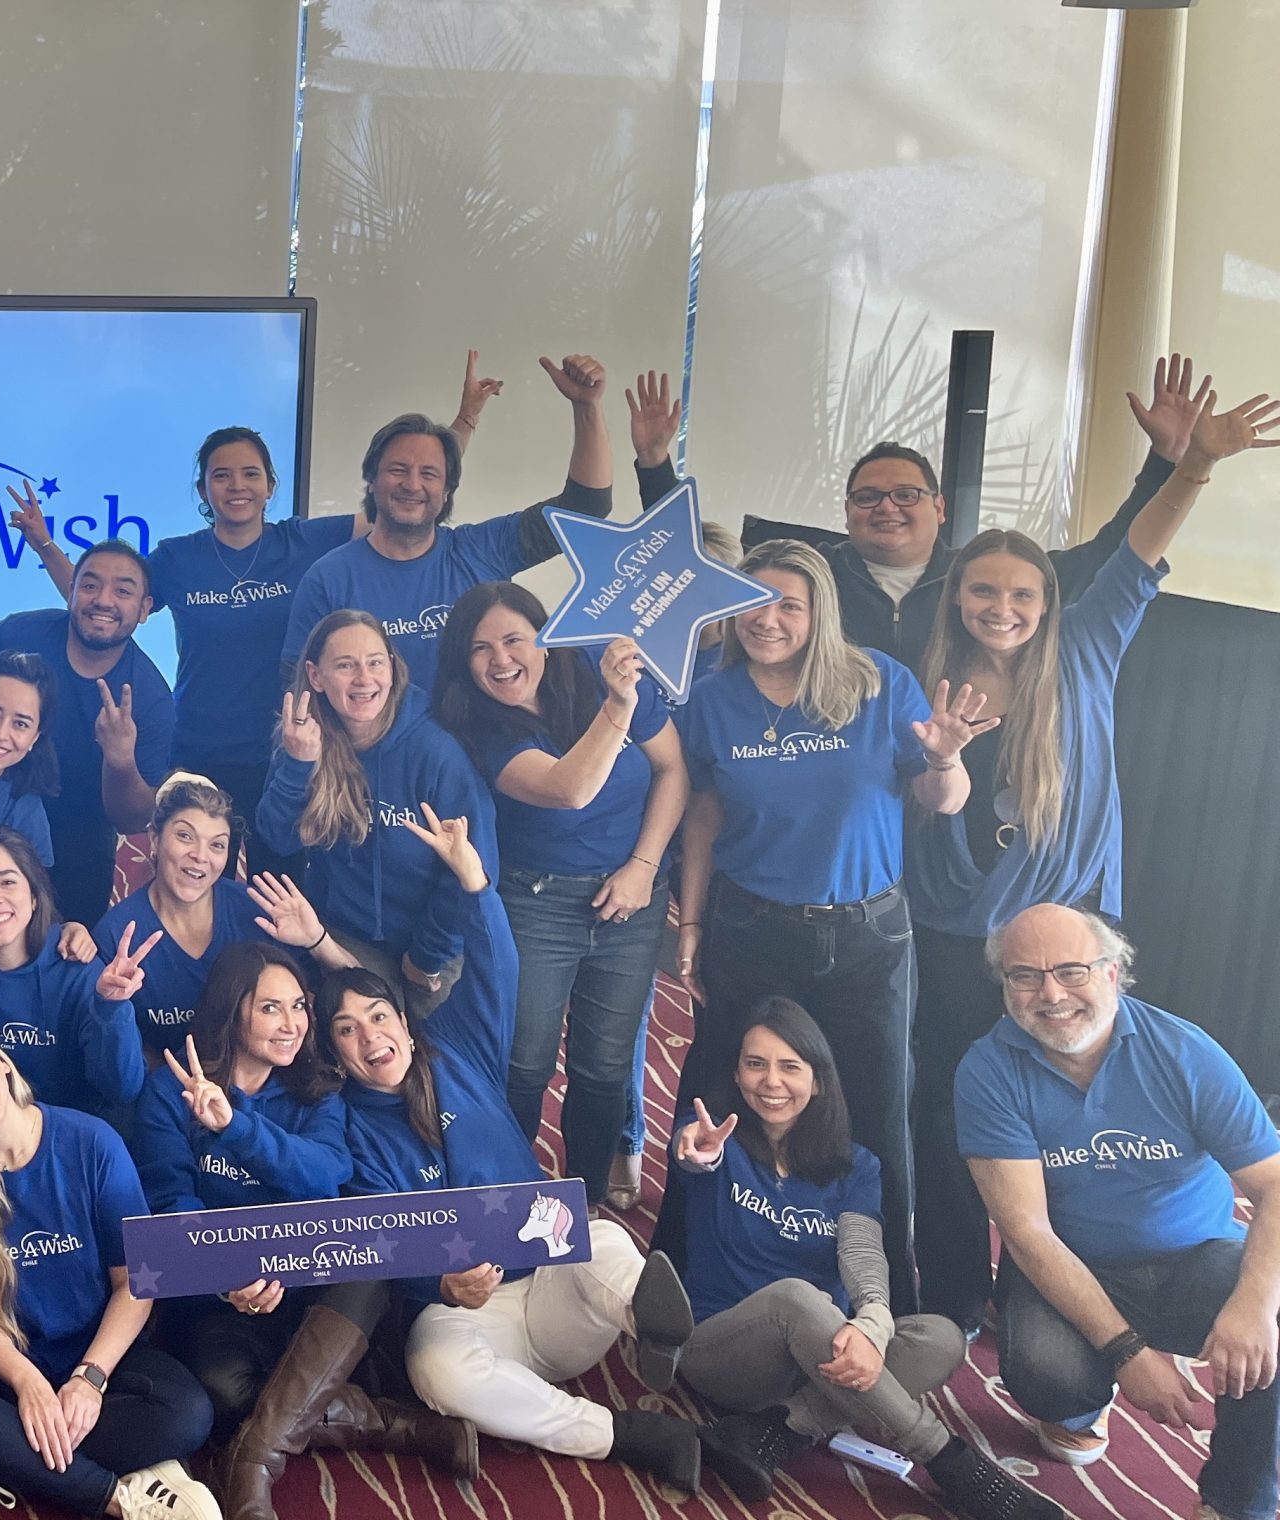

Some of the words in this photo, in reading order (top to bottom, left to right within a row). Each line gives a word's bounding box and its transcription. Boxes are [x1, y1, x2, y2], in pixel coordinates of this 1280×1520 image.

[630, 589, 655, 616] SOY
[651, 571, 674, 593] UN
[639, 568, 697, 628] WISHMAKER
[187, 1219, 328, 1246] VOLUNTARIOS
[332, 1209, 459, 1233] UNICORNIOS
